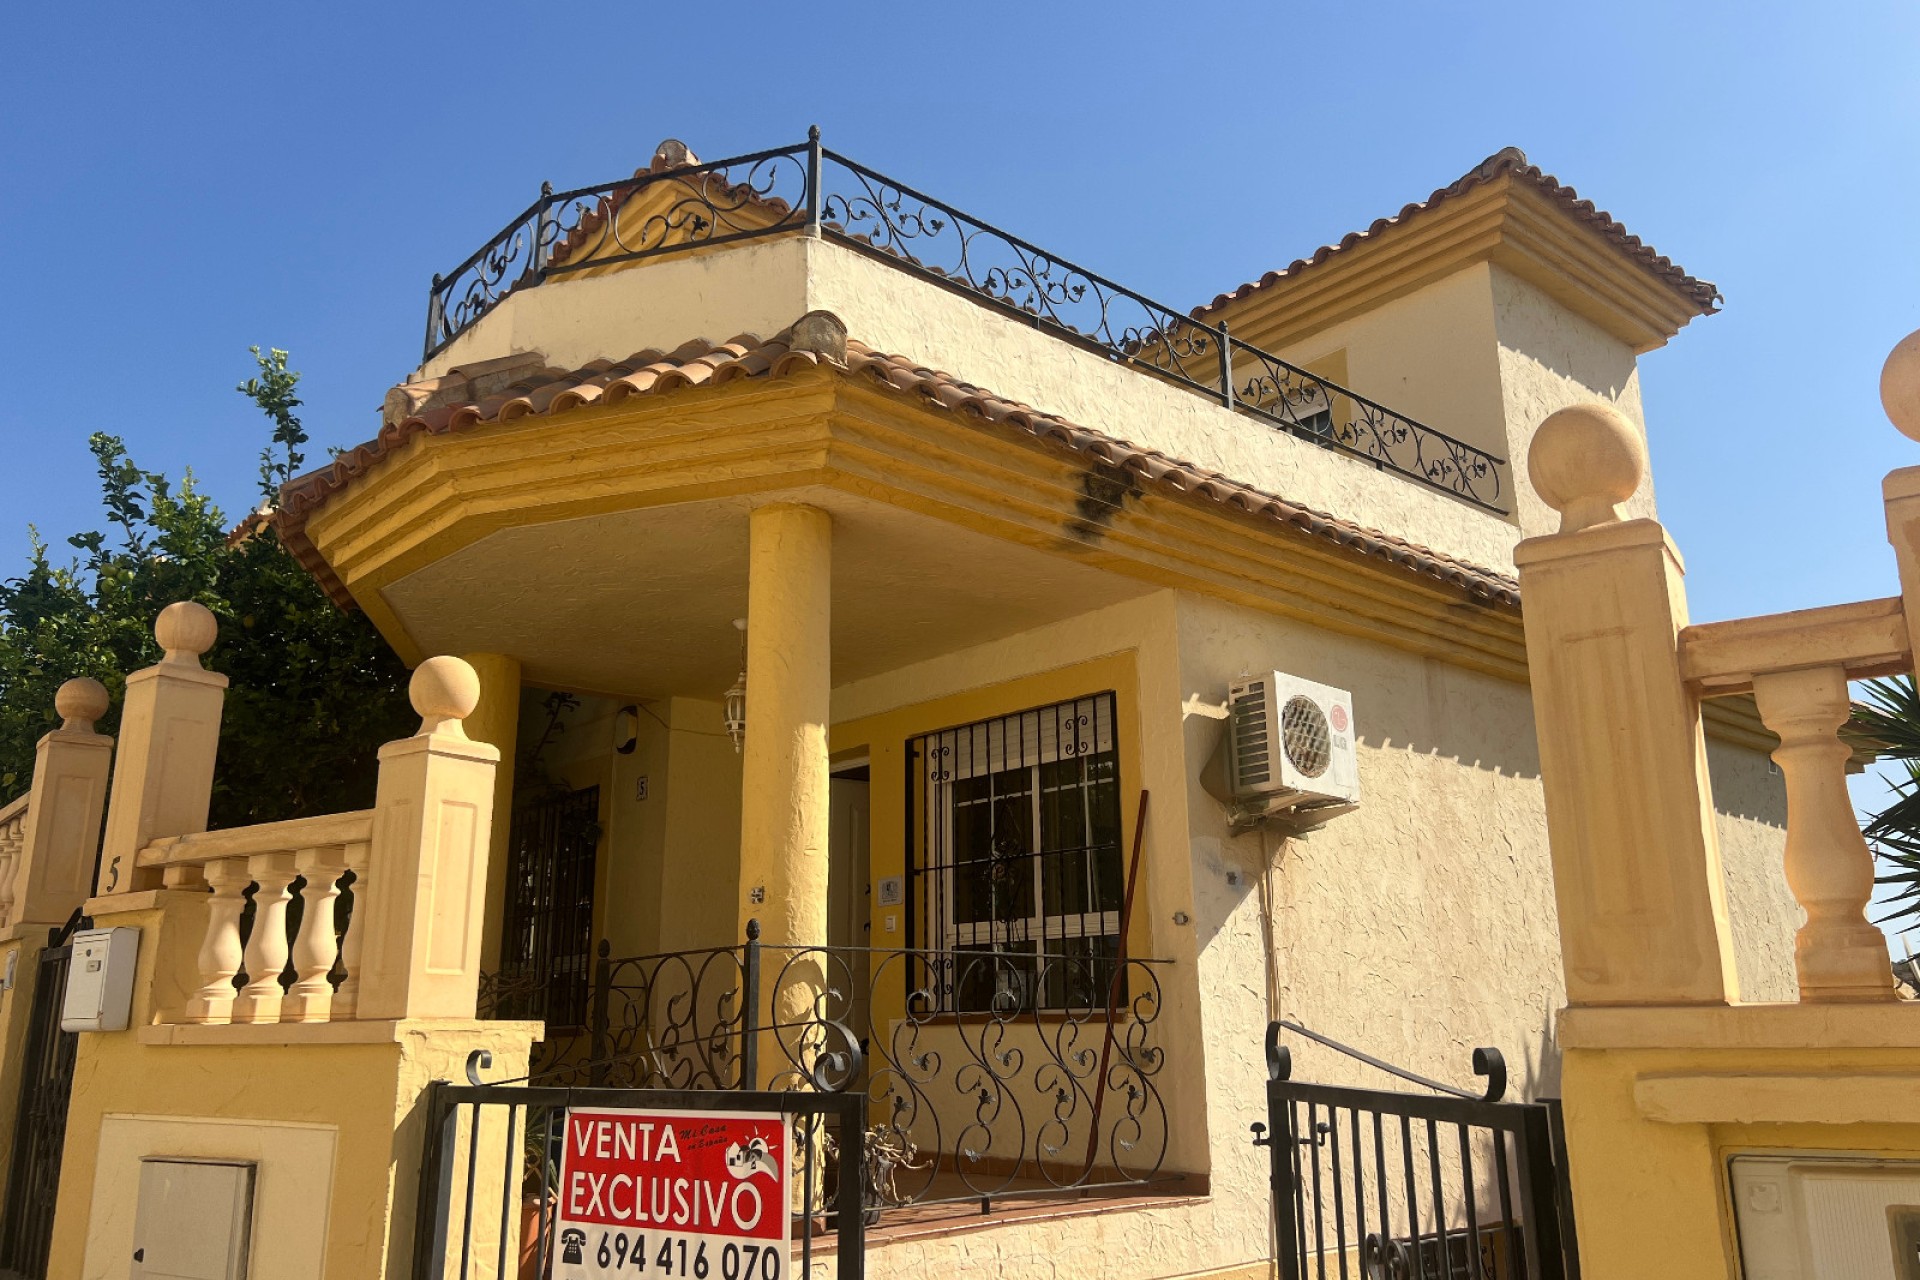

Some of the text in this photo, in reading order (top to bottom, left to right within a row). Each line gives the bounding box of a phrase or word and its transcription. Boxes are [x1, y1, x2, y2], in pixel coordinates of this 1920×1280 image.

[1333, 734, 1347, 751] LG
[106, 855, 121, 893] 5
[574, 1119, 682, 1163] VENTA
[569, 1171, 763, 1231] EXCLUSIVO
[597, 1231, 781, 1280] 694 416 070
